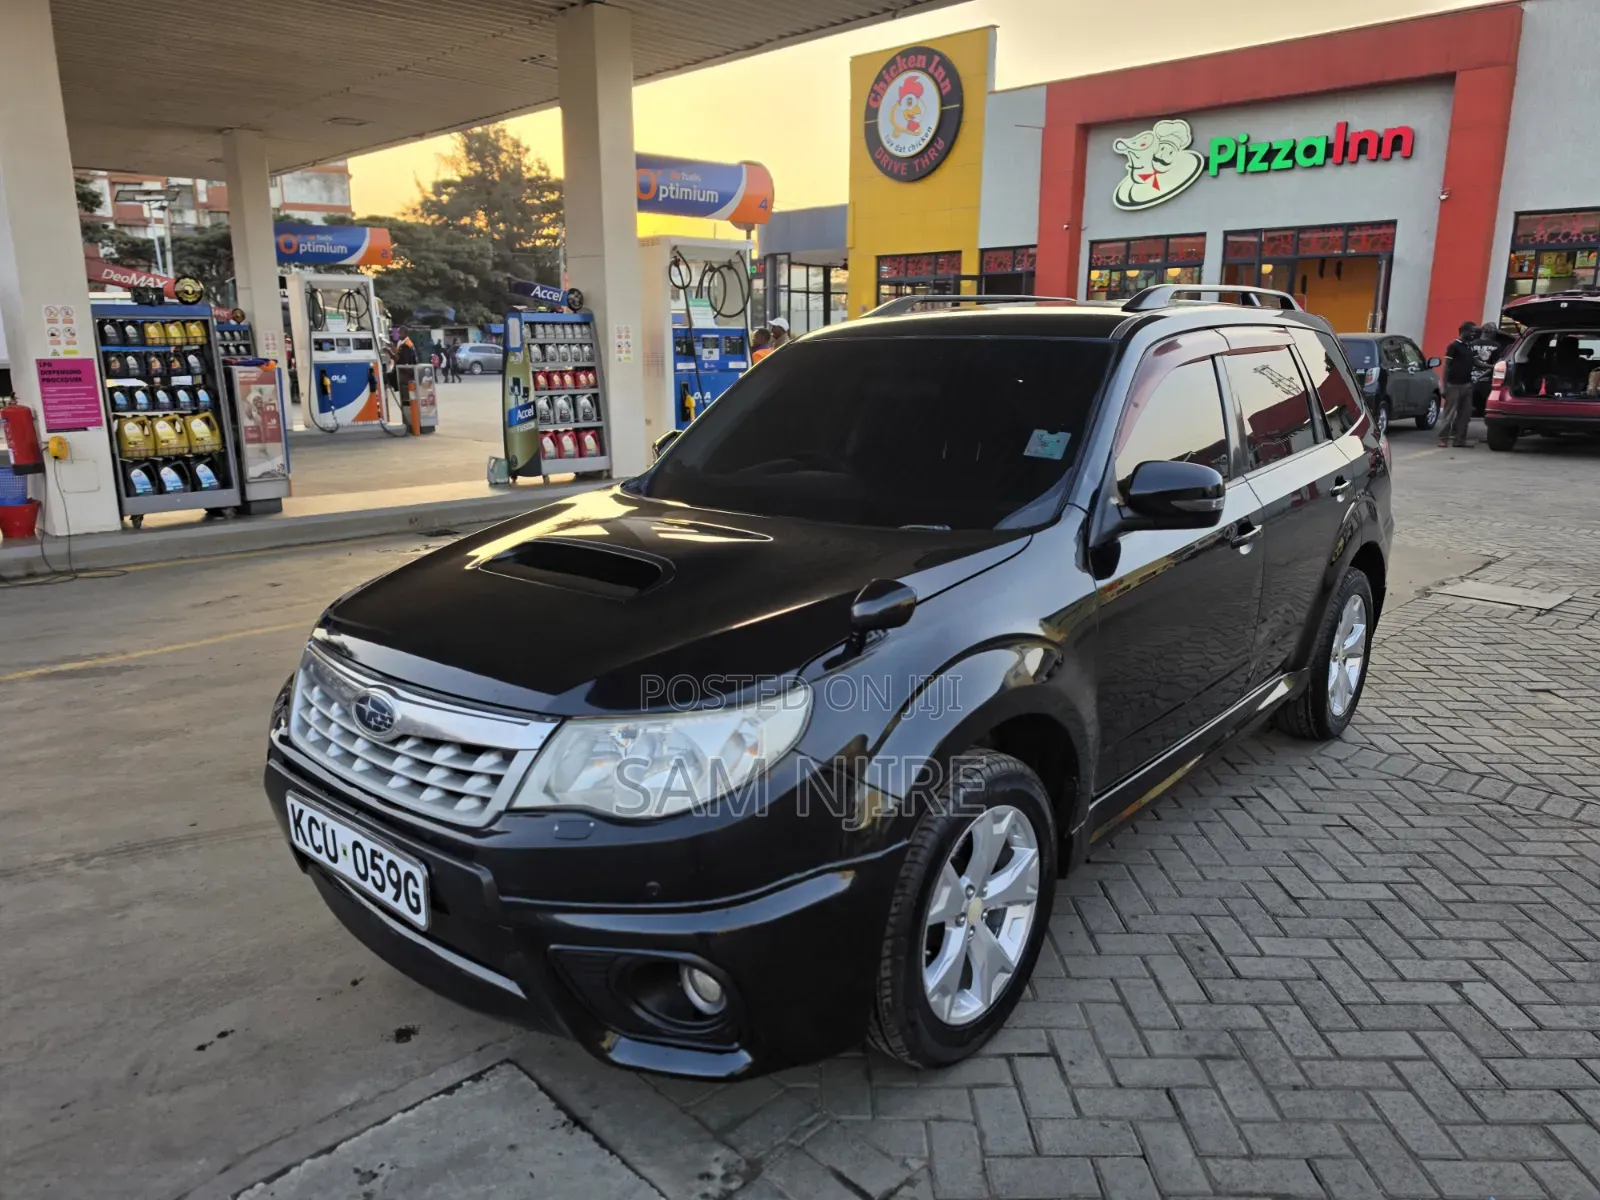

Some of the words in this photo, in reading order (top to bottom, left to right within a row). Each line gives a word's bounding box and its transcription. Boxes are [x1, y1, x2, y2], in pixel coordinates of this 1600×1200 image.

[868, 54, 926, 108] Chicken
[928, 54, 952, 95] Inn
[894, 143, 906, 153] dat
[907, 125, 932, 153] chicken
[875, 146, 909, 175] DRIVE
[914, 137, 945, 172] THRU
[637, 168, 719, 203] Optimium
[759, 198, 768, 211] 4
[278, 233, 348, 255] Optimium
[101, 268, 169, 288] DeoMAX
[530, 285, 564, 302] Accel
[331, 374, 347, 382] OLA
[516, 404, 534, 421] Accel
[290, 803, 339, 865] KCU
[351, 839, 422, 916] 059G
